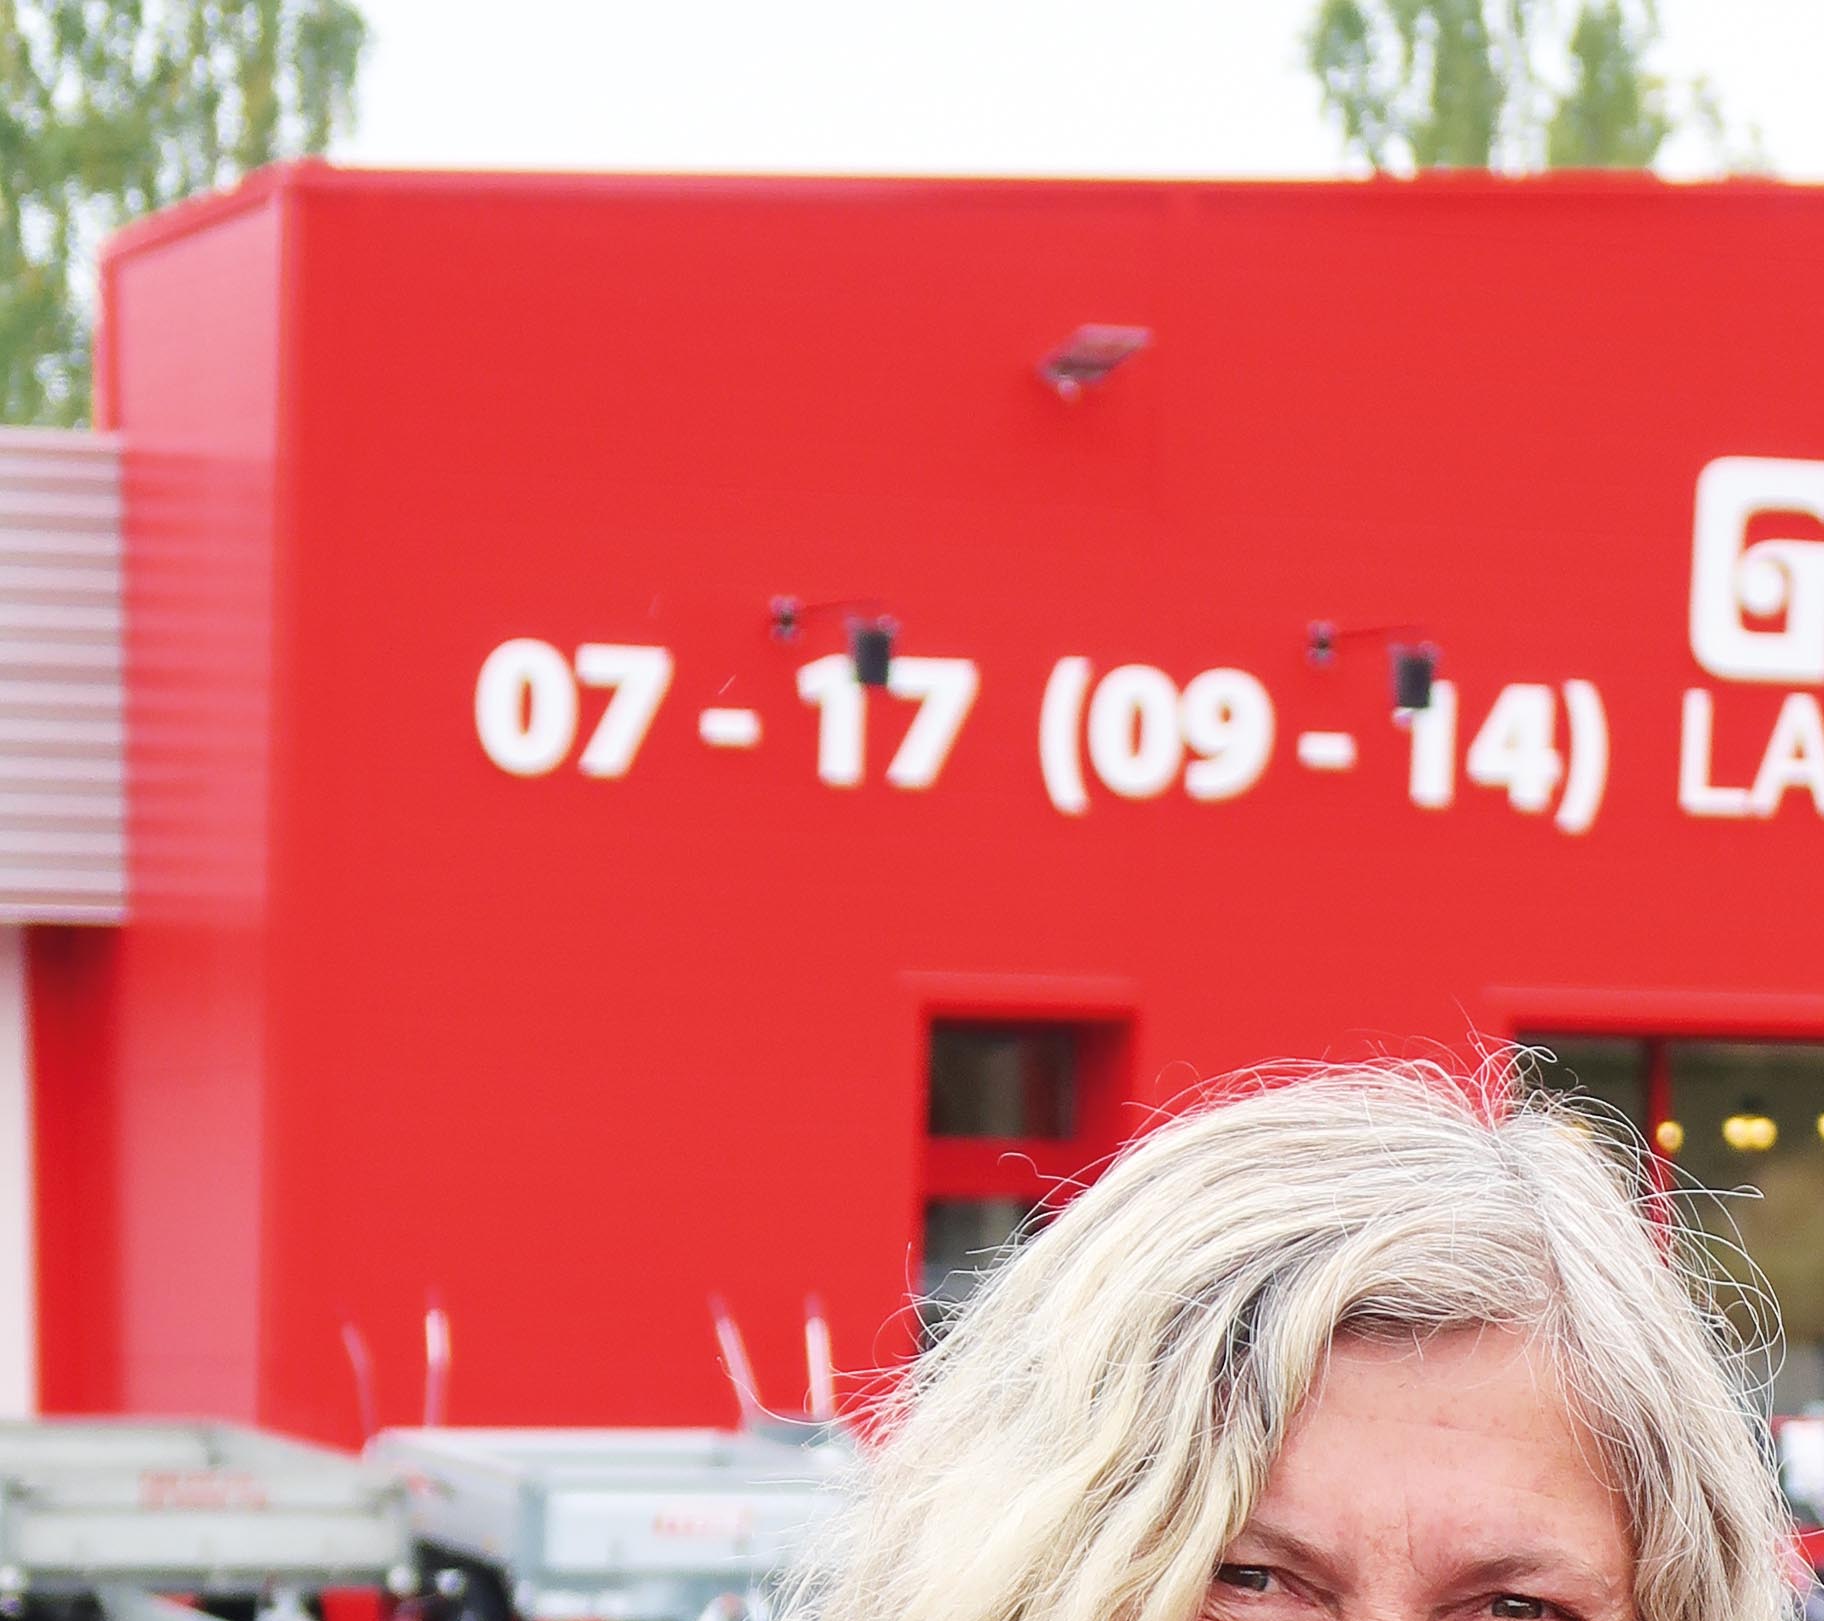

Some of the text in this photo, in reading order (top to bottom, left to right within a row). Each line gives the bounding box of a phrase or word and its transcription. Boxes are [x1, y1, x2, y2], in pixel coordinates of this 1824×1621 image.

[475, 638, 1609, 833] 07 - 17 (09 - 14)
